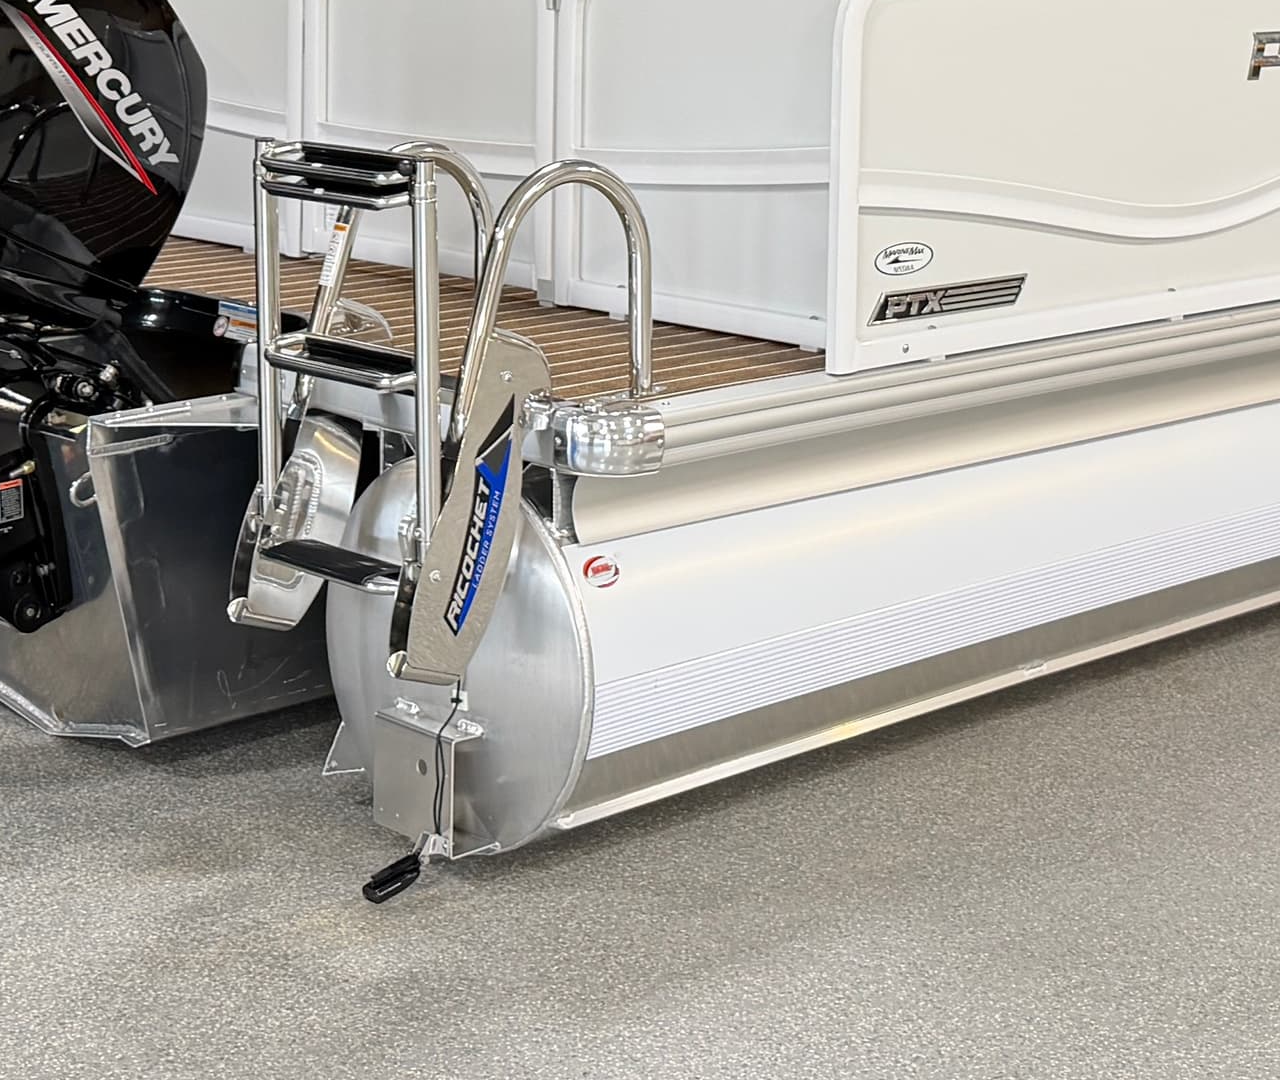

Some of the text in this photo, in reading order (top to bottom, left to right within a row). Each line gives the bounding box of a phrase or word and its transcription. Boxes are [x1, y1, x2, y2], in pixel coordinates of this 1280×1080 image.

[885, 290, 947, 319] PTX
[446, 476, 491, 631] RICOCHET
[473, 490, 501, 589] LADDER SYSTEM
